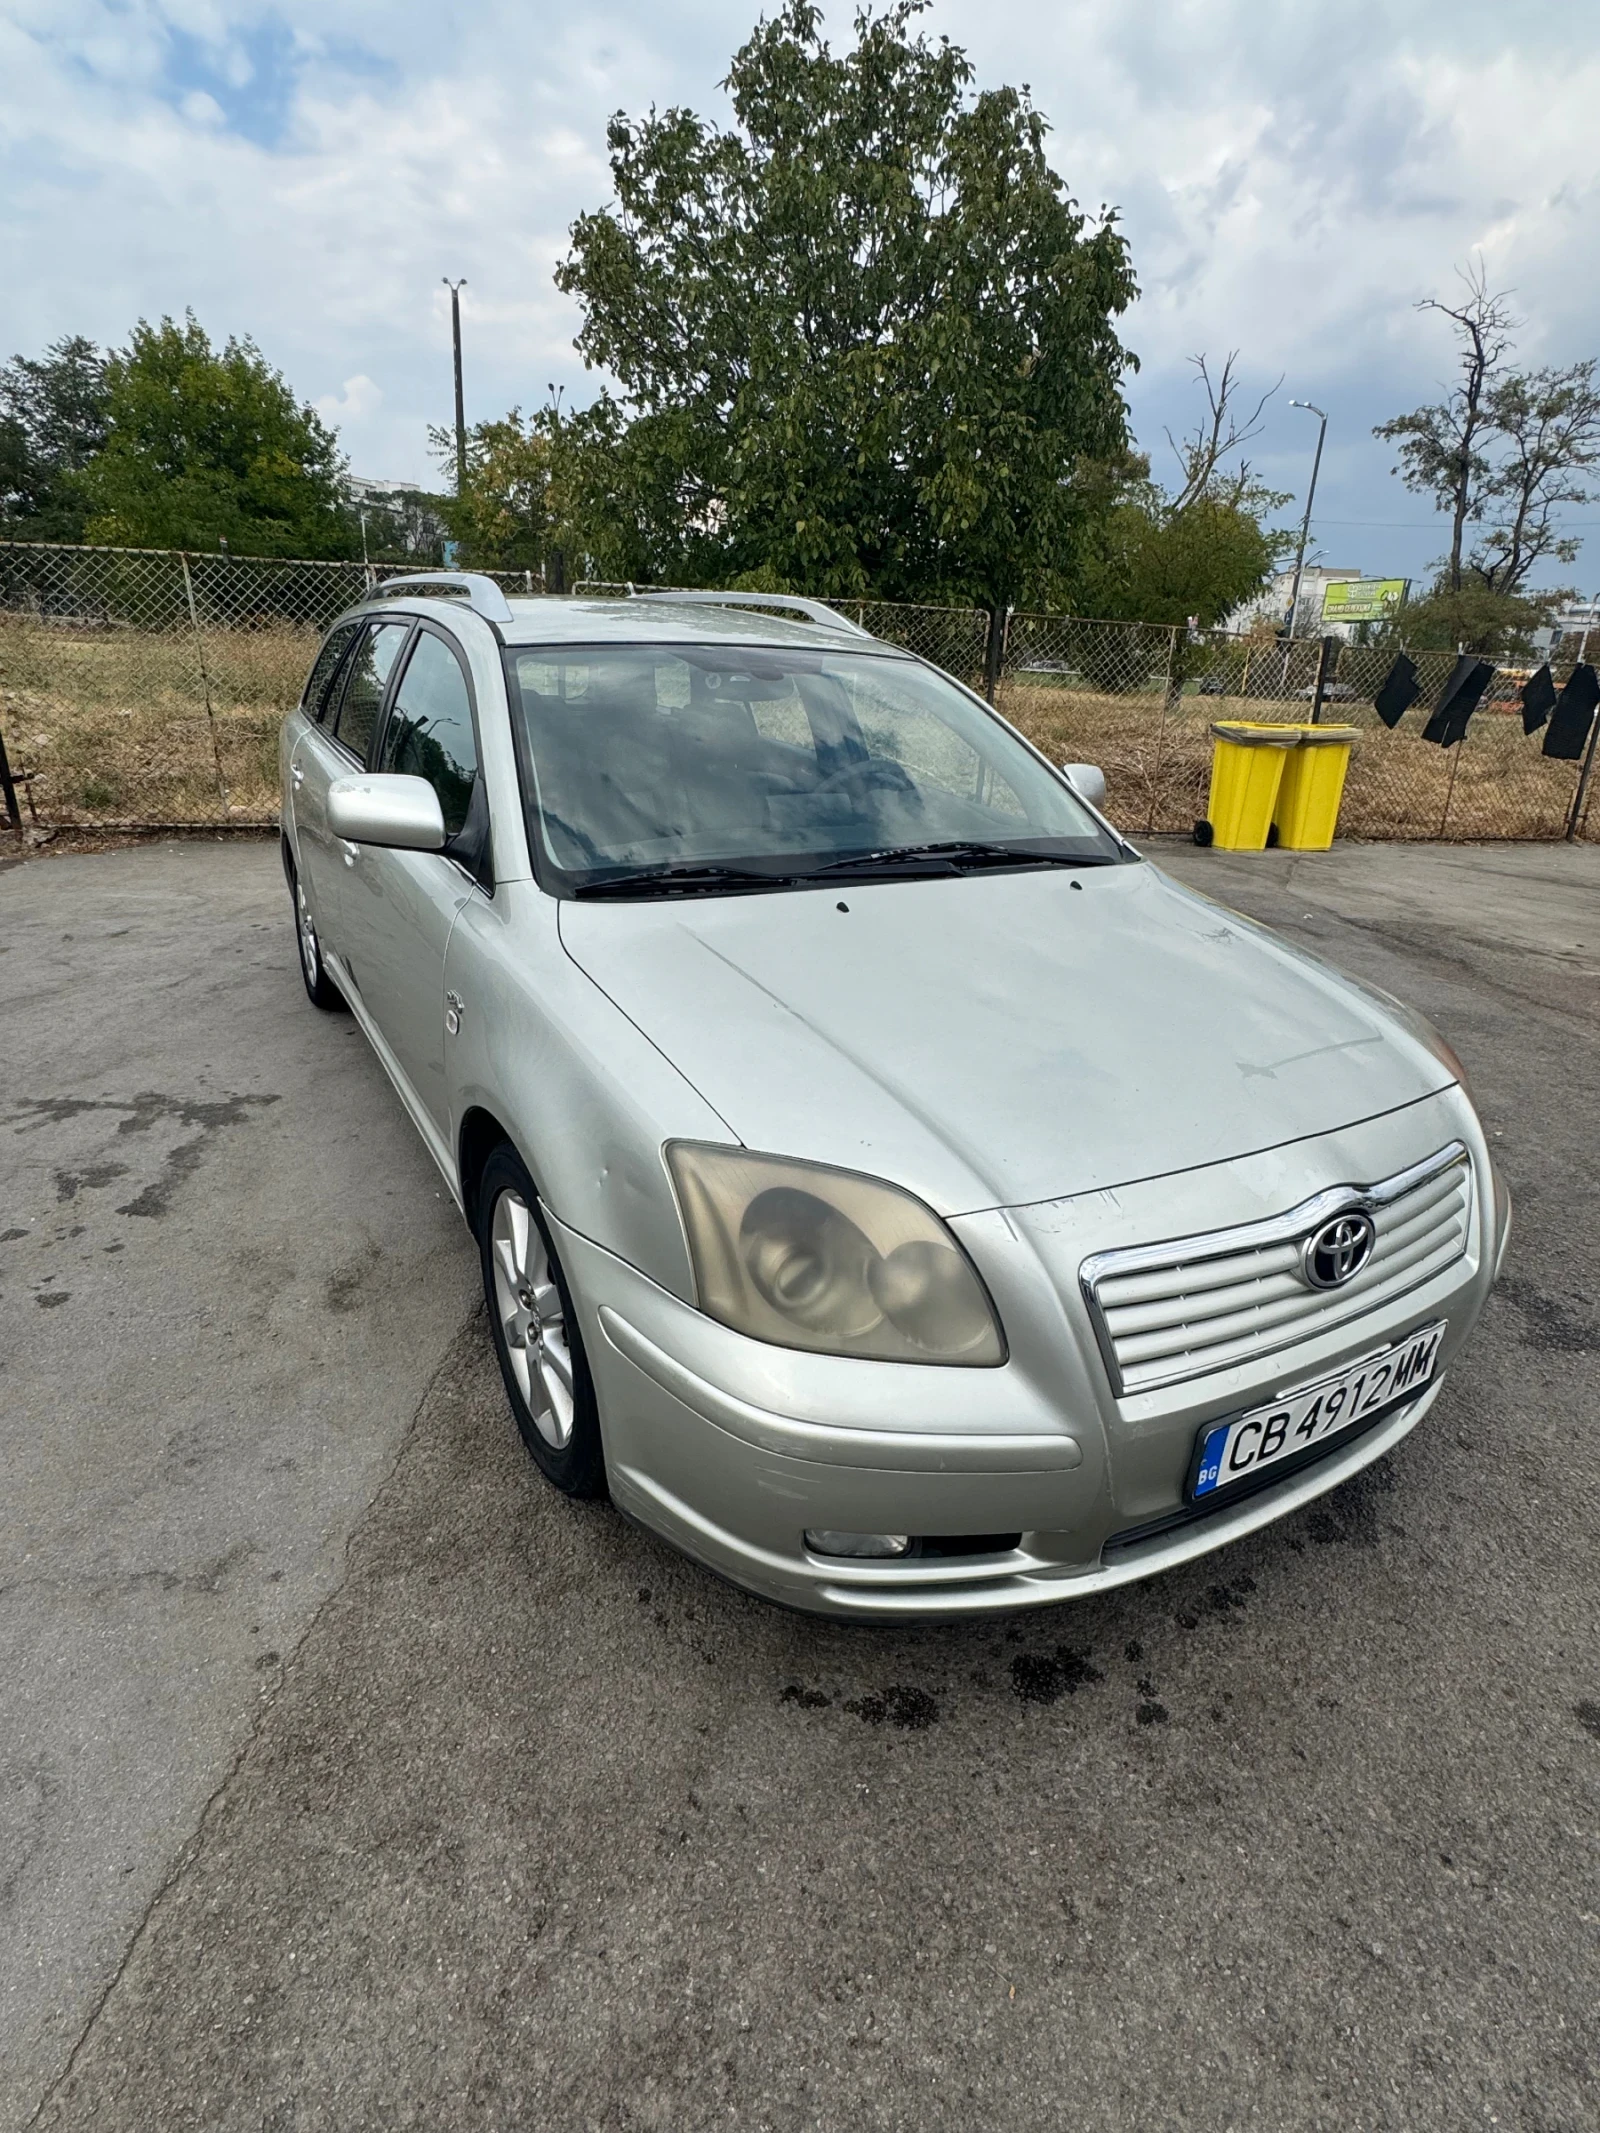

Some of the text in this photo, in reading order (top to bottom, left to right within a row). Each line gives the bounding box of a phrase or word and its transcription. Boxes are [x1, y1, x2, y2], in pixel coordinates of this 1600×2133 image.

[1228, 1411, 1291, 1472] CB
[1294, 1364, 1392, 1441] 4912
[1197, 1465, 1218, 1486] BG
